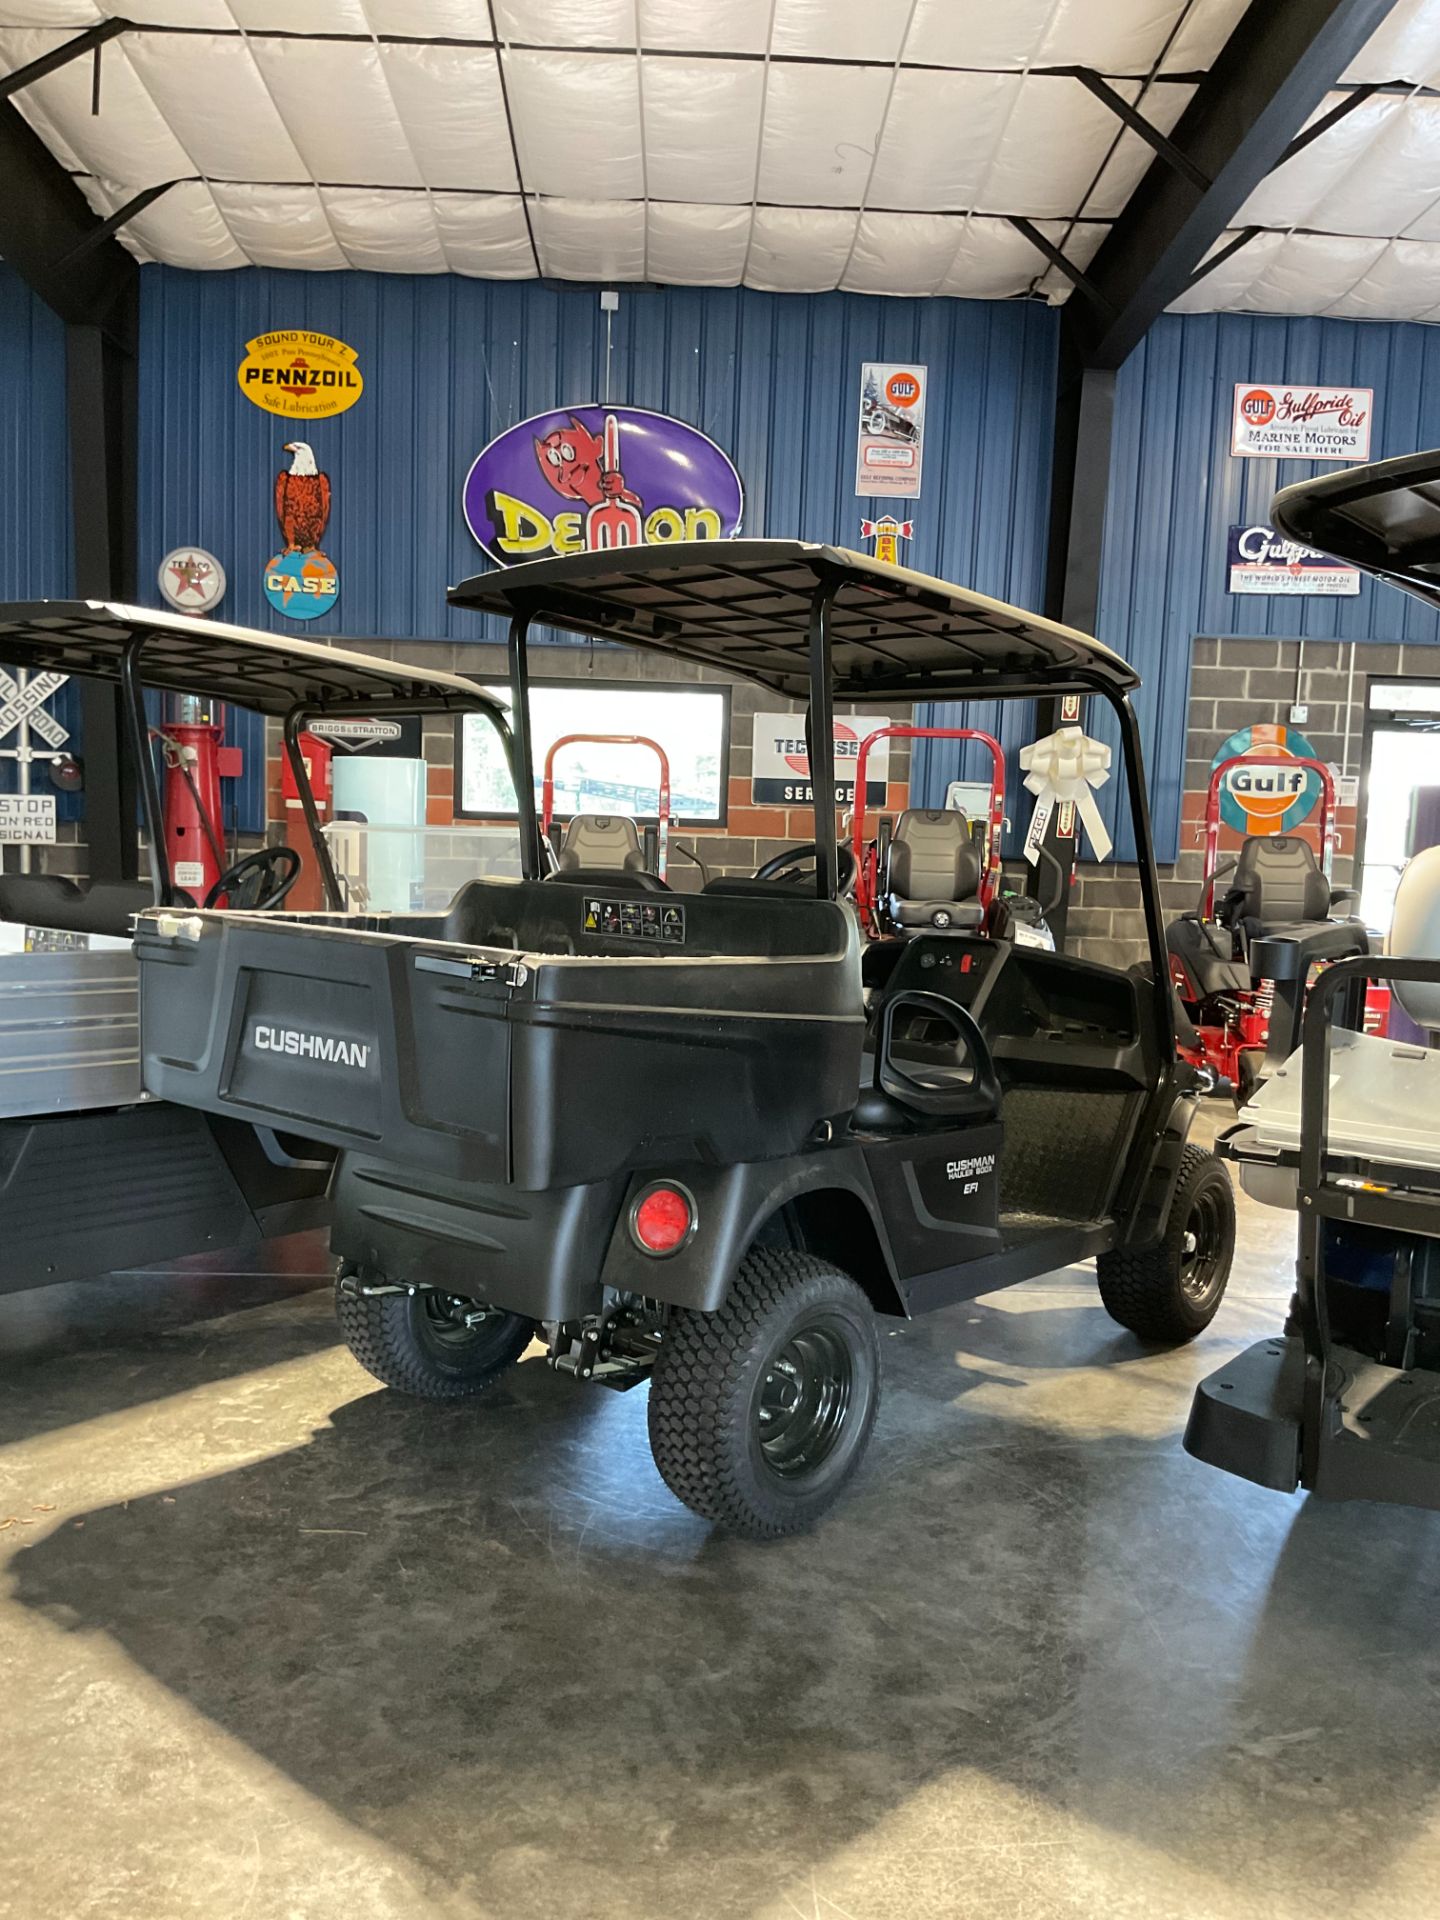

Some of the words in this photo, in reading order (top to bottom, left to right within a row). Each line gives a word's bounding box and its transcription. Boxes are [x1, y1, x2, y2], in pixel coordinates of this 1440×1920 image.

[256, 333, 298, 348] SOUND
[302, 334, 335, 349] YOUR
[339, 346, 348, 355] Z
[245, 368, 357, 387] PENNZOIL
[891, 382, 915, 396] GULF
[263, 393, 281, 408] Safe
[283, 399, 337, 413] Lubrication
[1243, 398, 1273, 415] GULF
[1276, 392, 1354, 423] Gulfpride
[1338, 409, 1366, 427] Oil
[1248, 431, 1300, 444] MARINE
[1304, 433, 1357, 446] MOTORS
[1258, 444, 1280, 452] FOR
[1285, 446, 1310, 454] SALE
[1315, 447, 1343, 455] HERE
[267, 575, 337, 595] CASE
[28, 708, 66, 745] ROAD
[1231, 770, 1303, 792] Gulf
[0, 800, 52, 813] STOP
[0, 817, 18, 826] ON
[24, 817, 54, 826] RED
[0, 830, 54, 840] SIGNAL
[255, 1026, 368, 1068] CUSHMAN
[946, 1154, 995, 1173] CUSHMAN
[948, 1169, 974, 1180] HAULER
[963, 1182, 979, 1195] EFI
